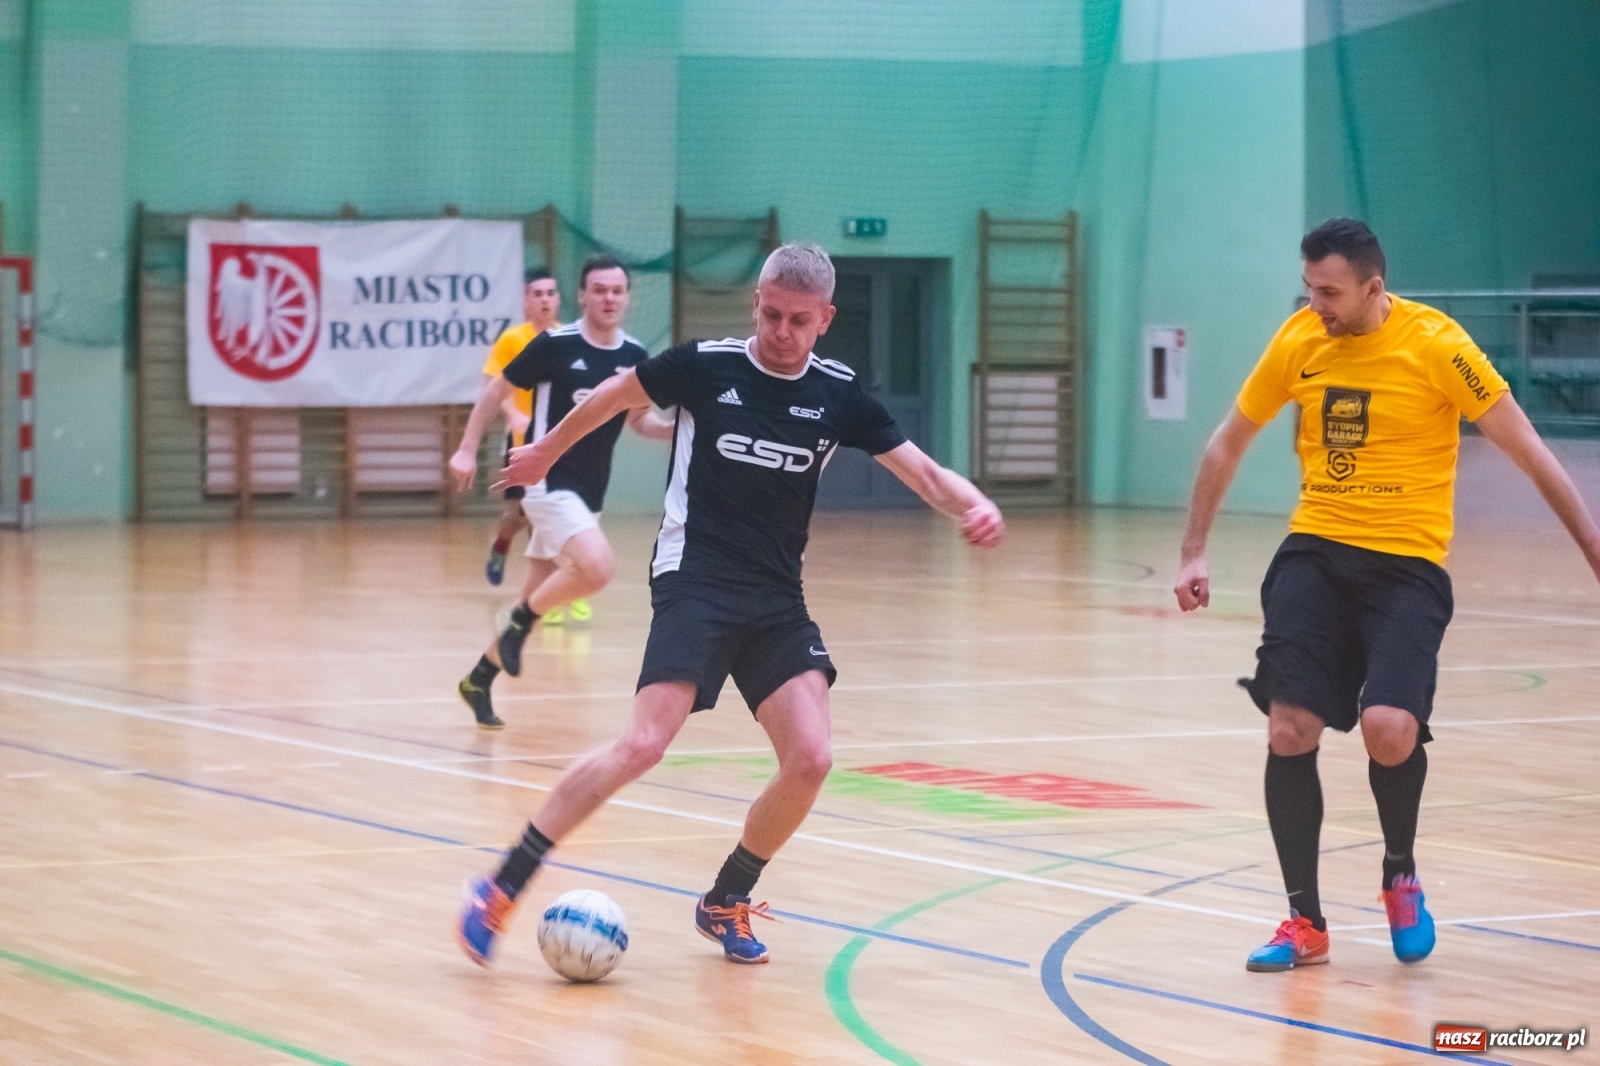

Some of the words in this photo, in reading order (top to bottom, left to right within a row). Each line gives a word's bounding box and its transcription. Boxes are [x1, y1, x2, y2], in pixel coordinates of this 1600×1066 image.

[352, 273, 490, 305] MIASTO
[788, 406, 822, 420] ESD
[1326, 430, 1364, 441] GARAGE
[716, 433, 815, 473] ESD
[1310, 485, 1404, 494] PRODUCTIONS
